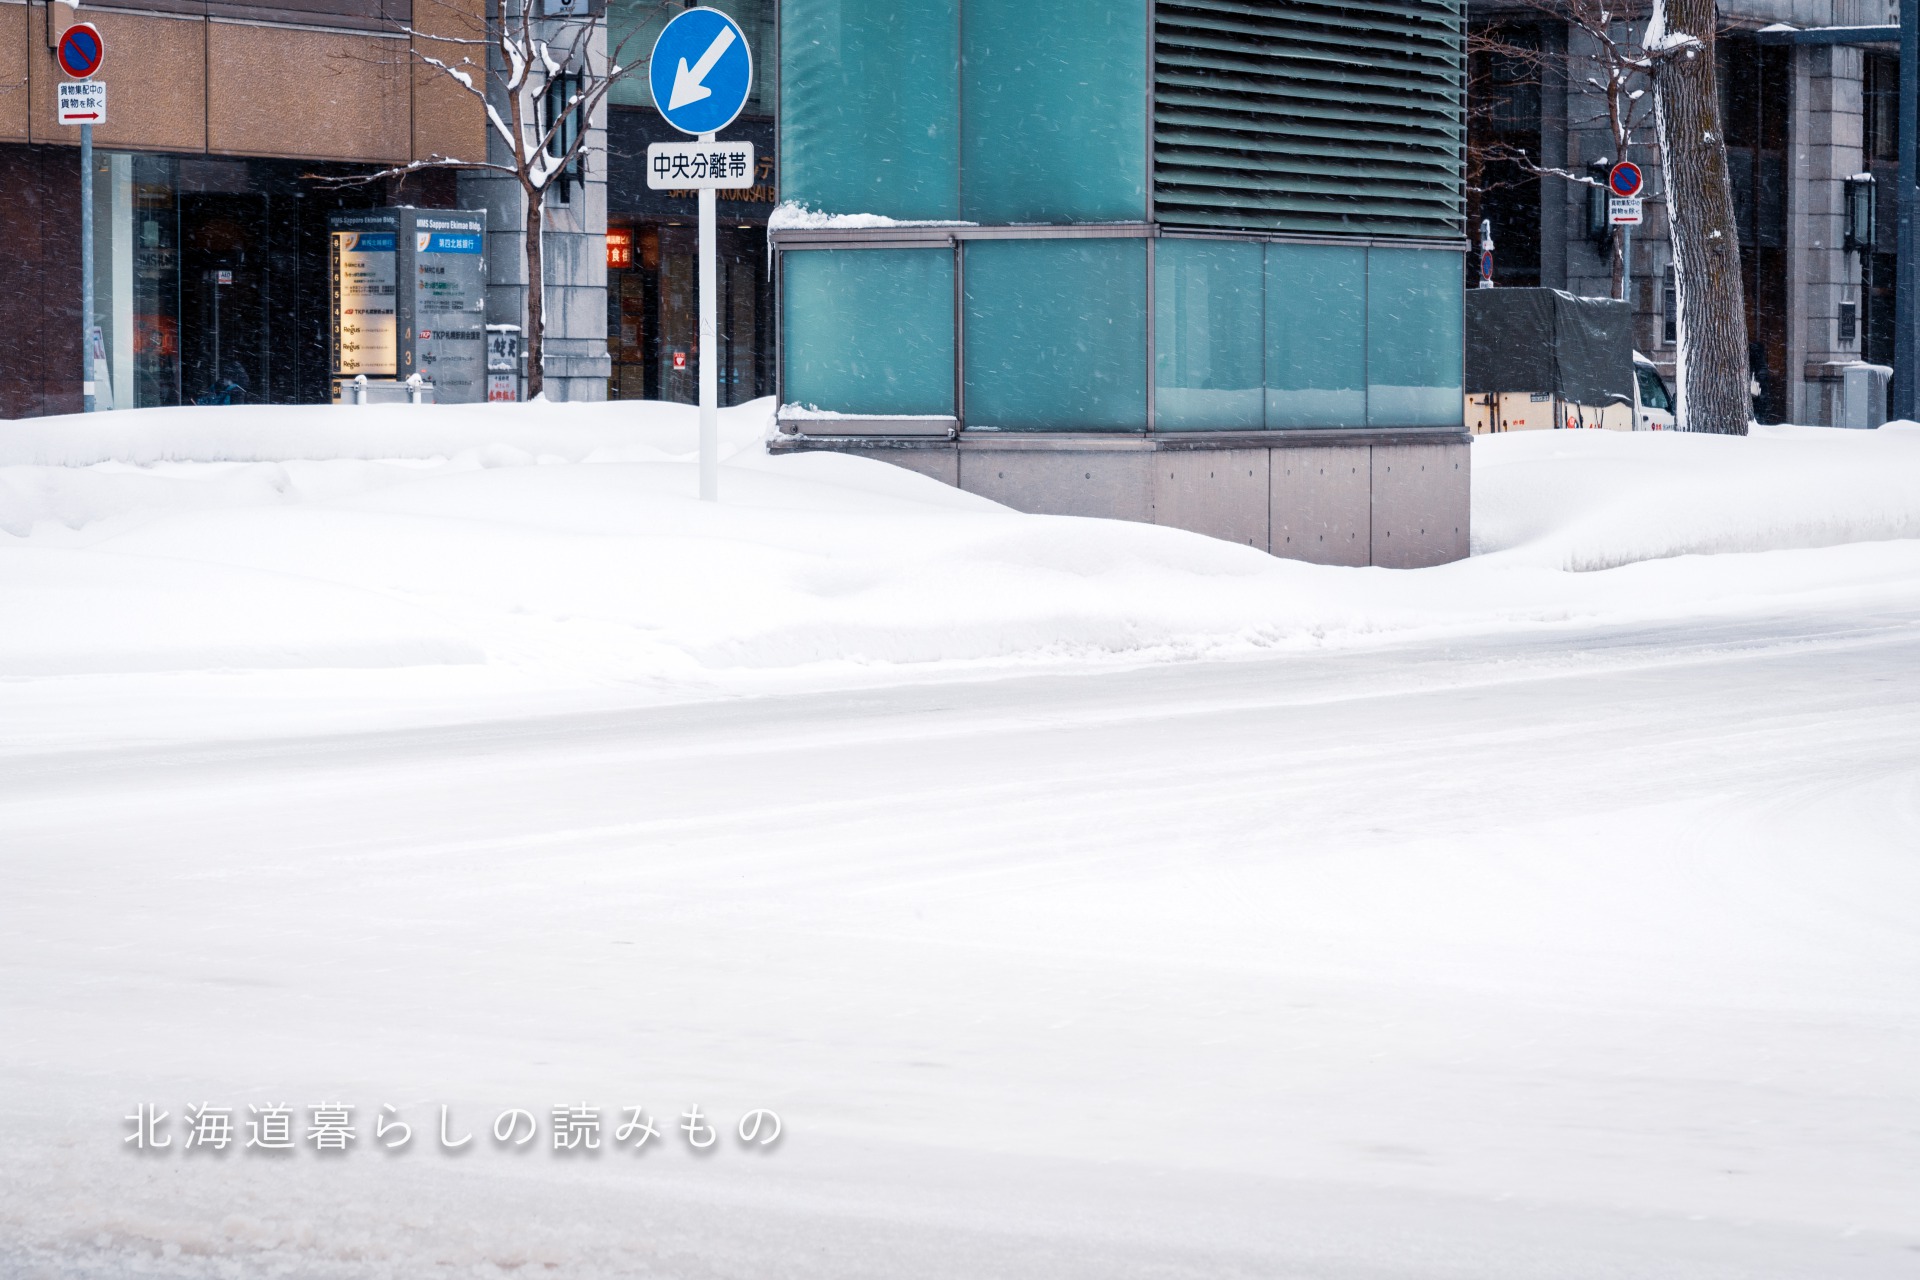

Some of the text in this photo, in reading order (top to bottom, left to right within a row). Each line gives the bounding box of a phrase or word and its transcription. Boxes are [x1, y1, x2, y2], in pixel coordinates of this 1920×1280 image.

[60, 84, 103, 95] 貨物集配中の
[60, 97, 103, 108] 貨物を除く
[653, 152, 746, 179] 中央分離帯
[429, 219, 449, 231] Sapporo
[450, 221, 468, 230] Ekimae
